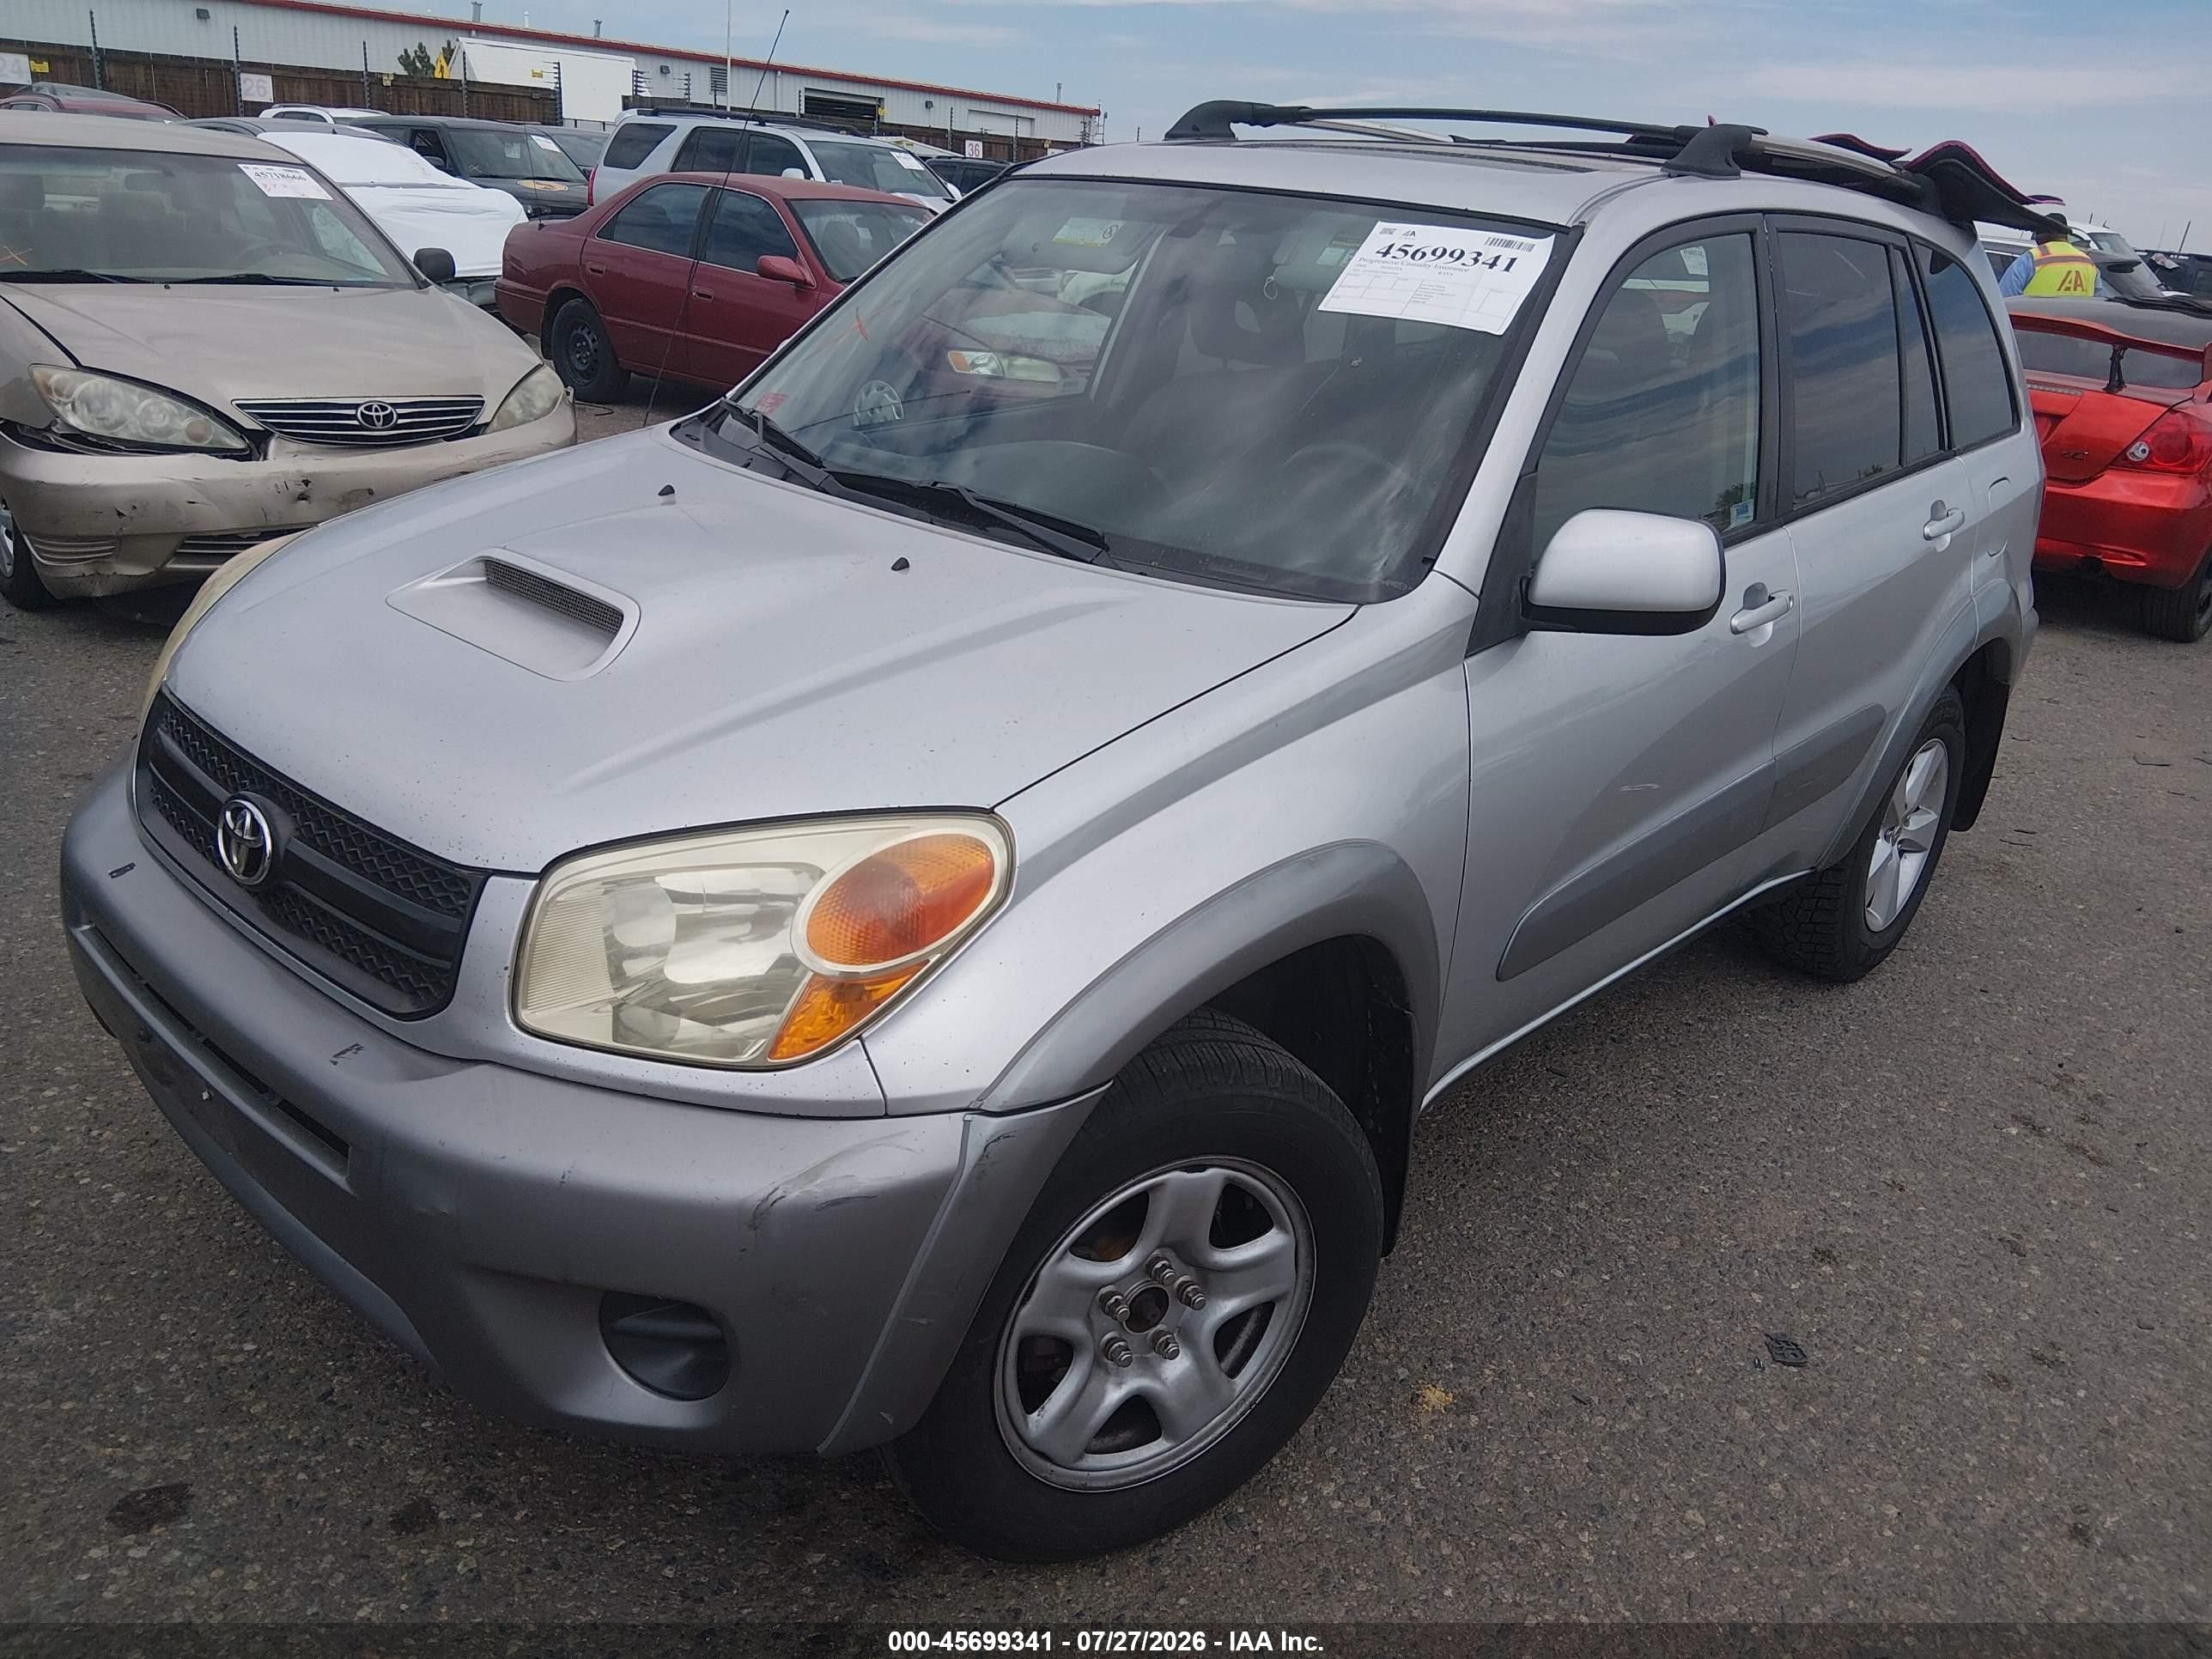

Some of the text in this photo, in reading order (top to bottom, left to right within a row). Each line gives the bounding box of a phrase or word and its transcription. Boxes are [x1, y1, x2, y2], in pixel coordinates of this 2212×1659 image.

[243, 78, 267, 97] 26
[969, 143, 980, 157] 36
[1358, 258, 1400, 266] Progressive
[1401, 259, 1431, 269] Casualty
[1434, 264, 1470, 272] Insurance
[1376, 242, 1518, 273] 45699341
